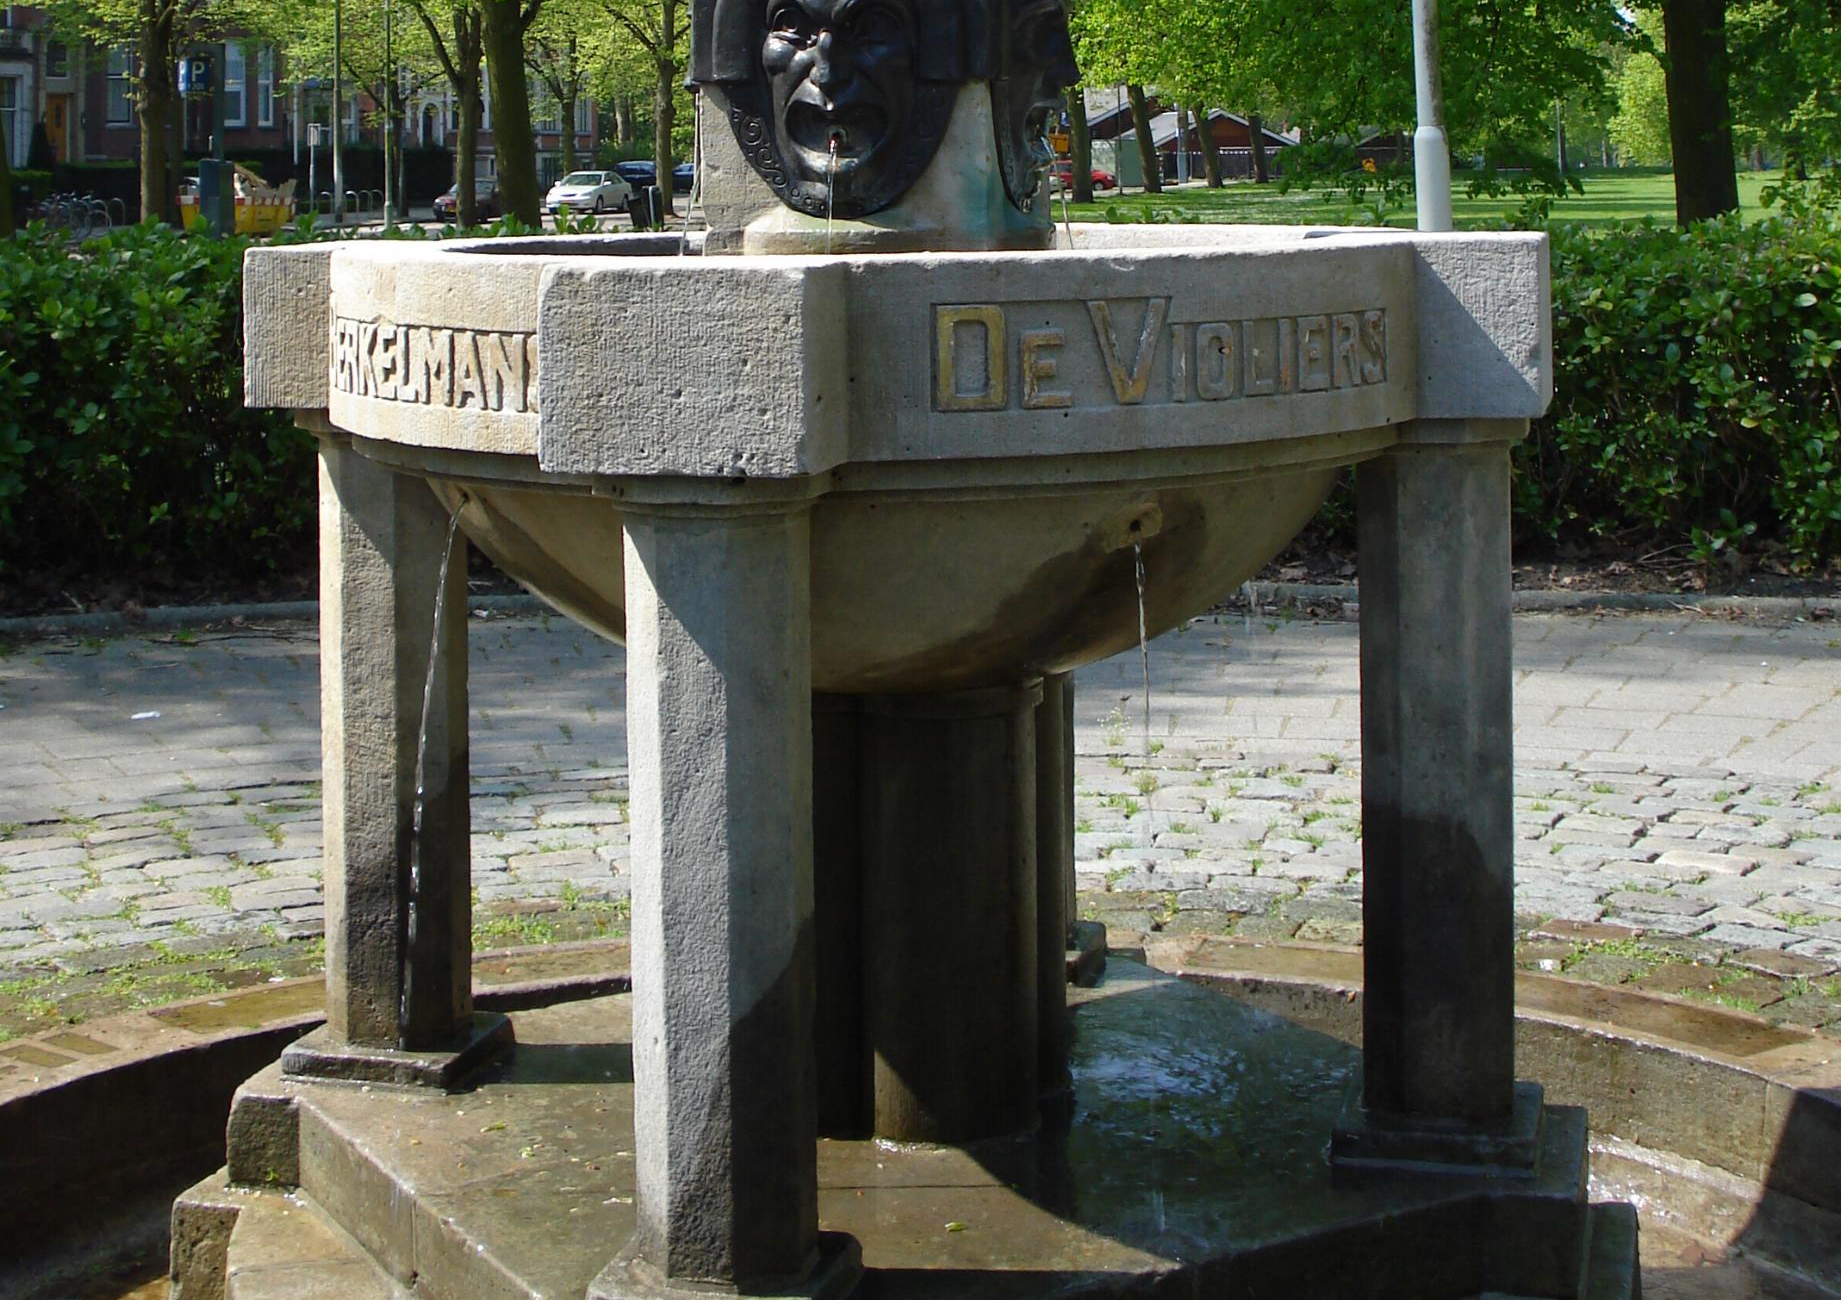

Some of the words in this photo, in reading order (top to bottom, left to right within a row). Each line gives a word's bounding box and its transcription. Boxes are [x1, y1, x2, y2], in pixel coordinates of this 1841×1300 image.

[191, 61, 205, 82] P
[935, 304, 1073, 411] DE
[1087, 297, 1387, 405] VIOLIERS
